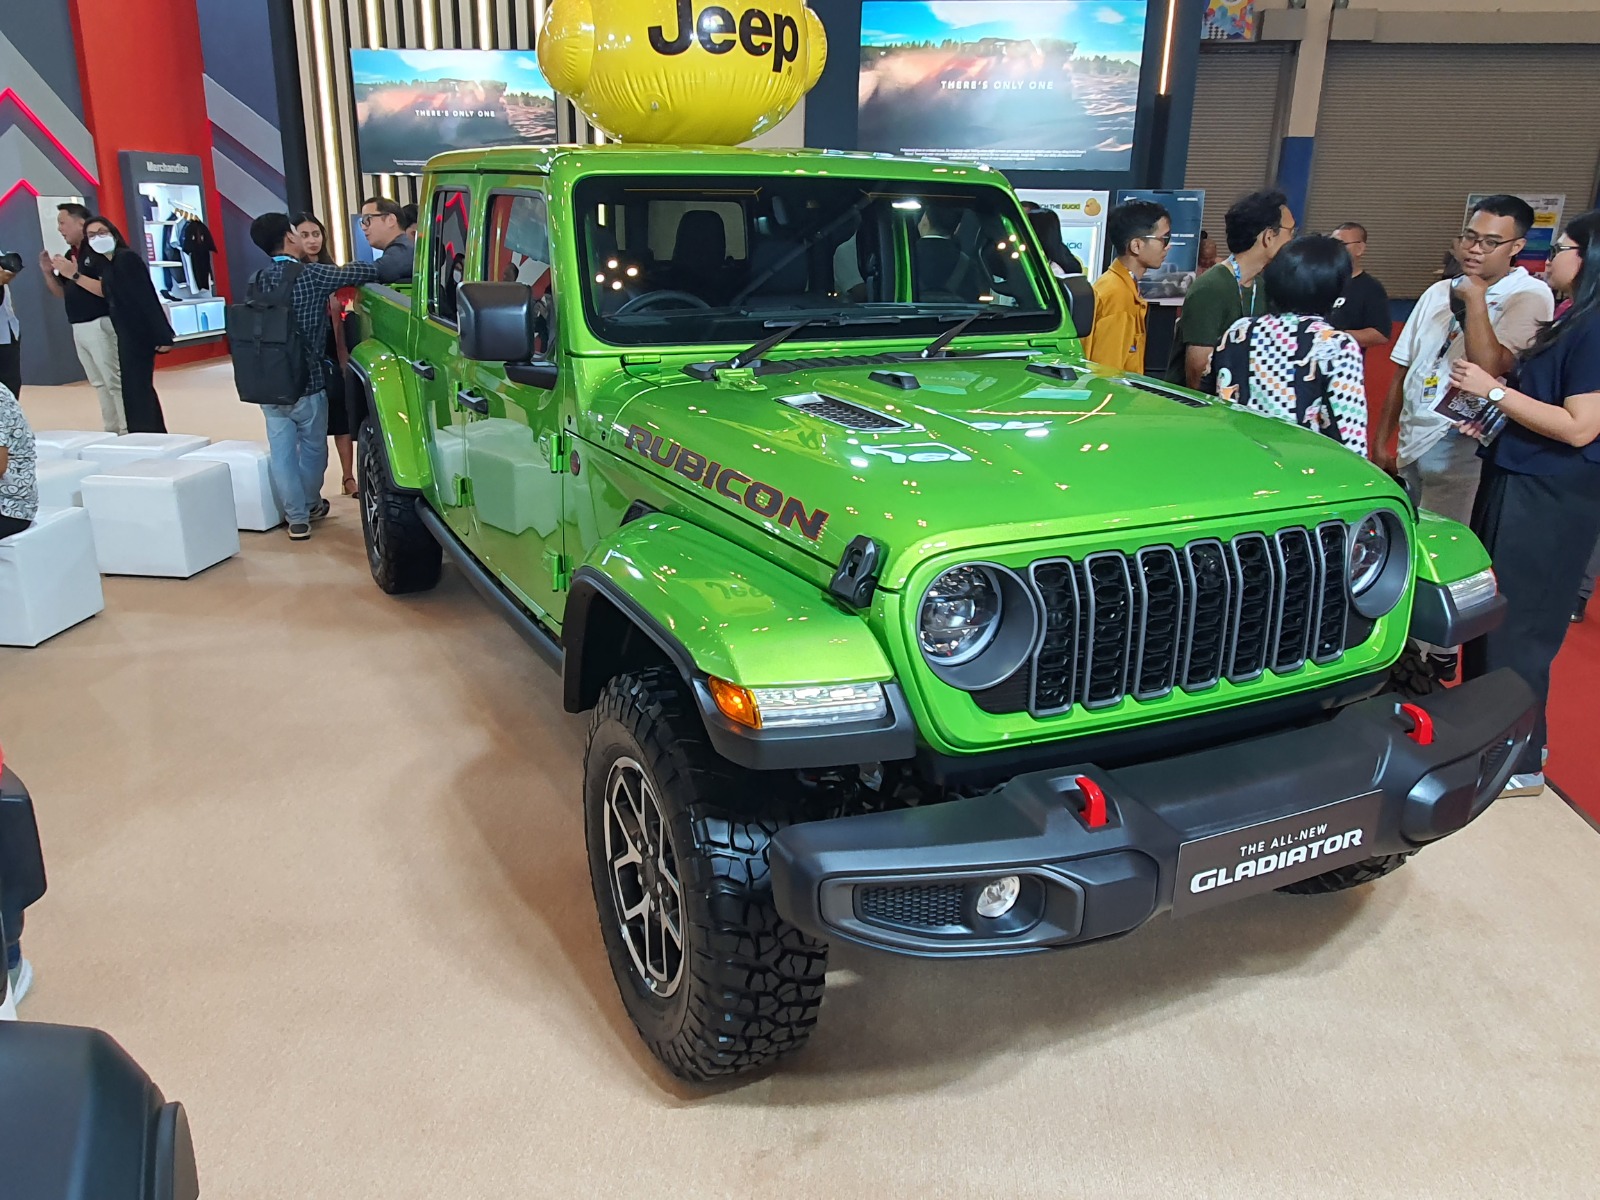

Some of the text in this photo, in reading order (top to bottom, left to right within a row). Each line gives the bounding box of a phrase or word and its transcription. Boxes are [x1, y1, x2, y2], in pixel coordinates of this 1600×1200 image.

[648, 0, 798, 73] Jeep
[941, 81, 1054, 90] THERE'S ONLY ONE
[415, 110, 496, 118] THERE'S ONLY ONE
[624, 424, 829, 541] RUBICON
[1190, 828, 1363, 894] GLADIATOR
[1240, 823, 1328, 857] THE ALL-NEW
